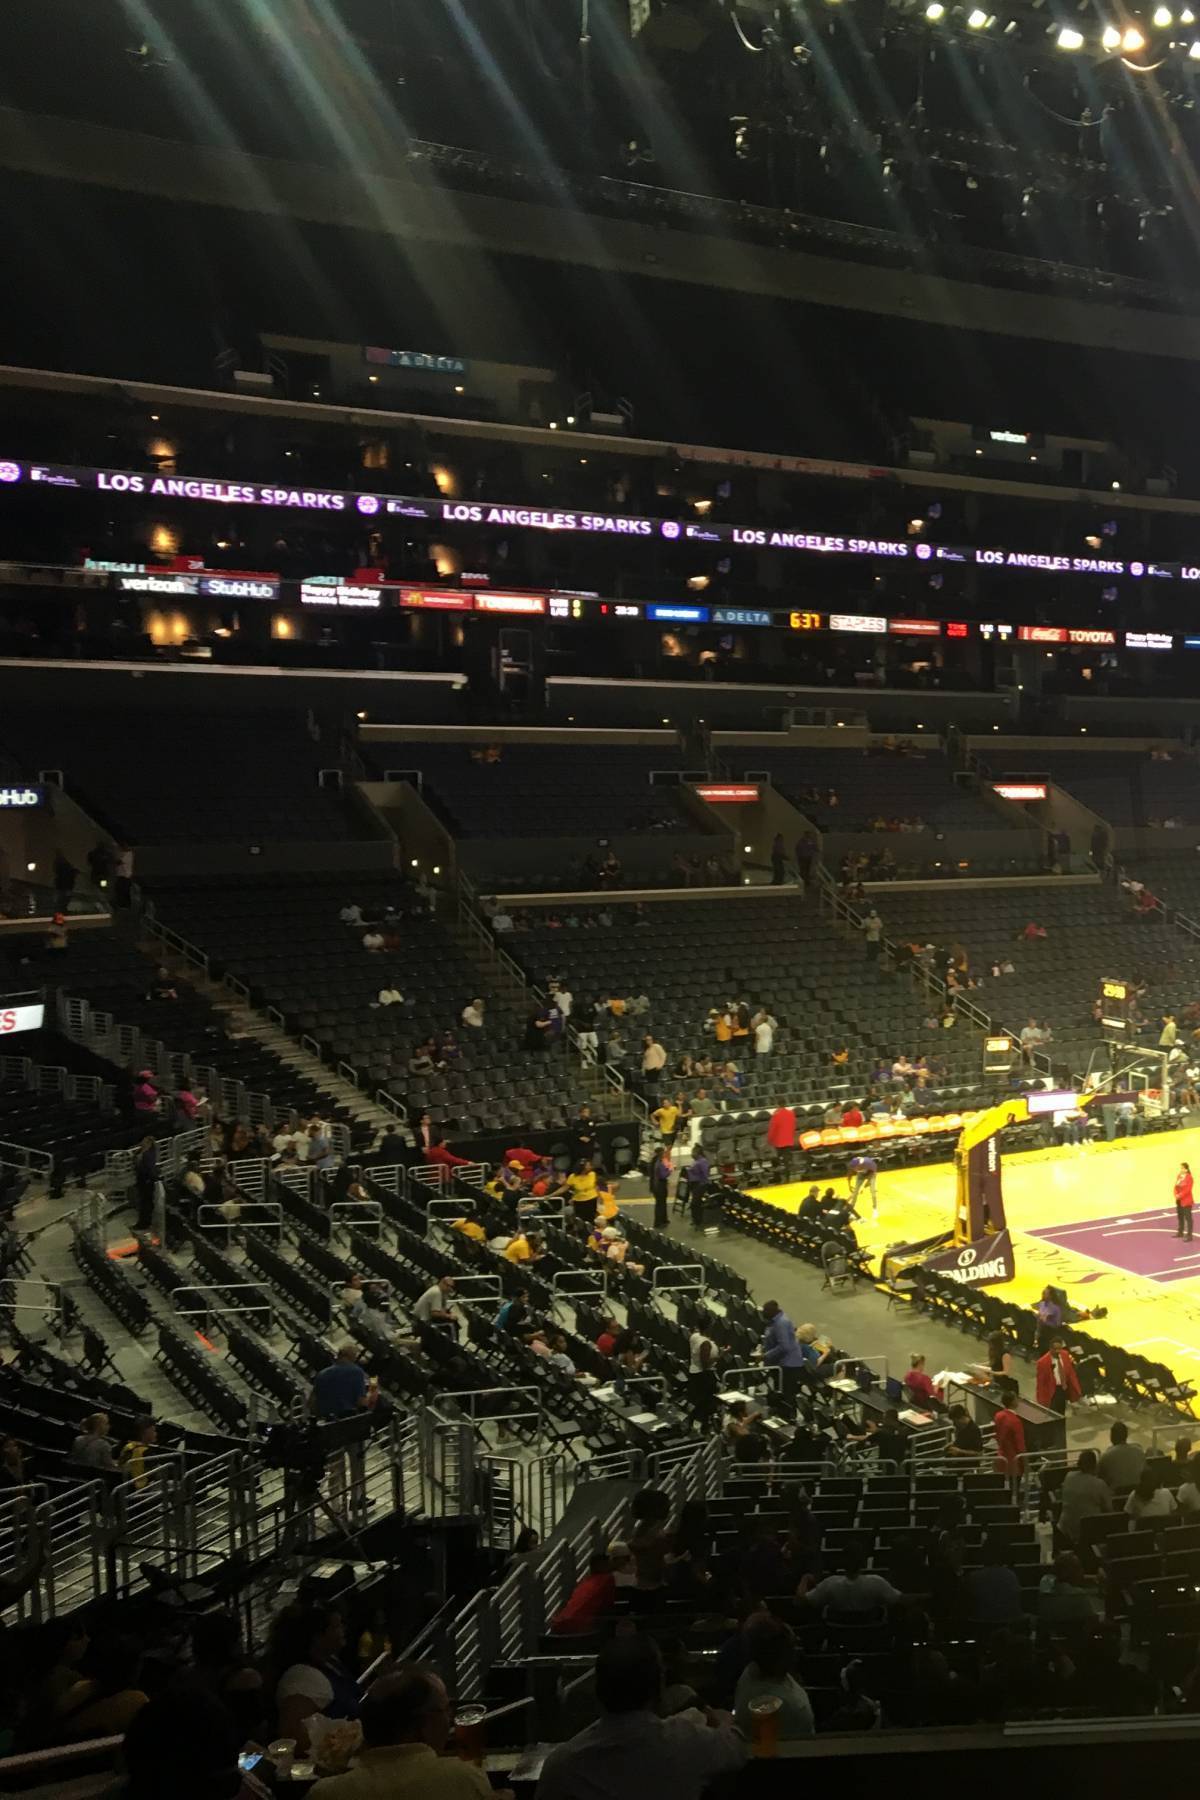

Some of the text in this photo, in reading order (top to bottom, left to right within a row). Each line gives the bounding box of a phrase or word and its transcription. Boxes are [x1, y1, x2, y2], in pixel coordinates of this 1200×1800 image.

[98, 473, 144, 493] LOS
[151, 478, 255, 504] ANGELES
[260, 488, 345, 510] SPARKS
[443, 504, 483, 521] LOS
[487, 509, 576, 530] ANGELES
[581, 516, 652, 535] SPARKS
[733, 529, 766, 545] LOS
[769, 533, 845, 551] ANGELES
[848, 539, 908, 556] SPARKS
[976, 550, 1004, 564] LOS
[1007, 553, 1070, 570] ANGELES
[1073, 558, 1124, 573] SPARKS
[121, 577, 184, 594] verizon
[208, 579, 273, 598] StubHub
[727, 611, 769, 622] DELTA
[831, 617, 887, 632] STAPLES
[1069, 631, 1115, 642] TOYOTA
[988, 1137, 996, 1172] verizon
